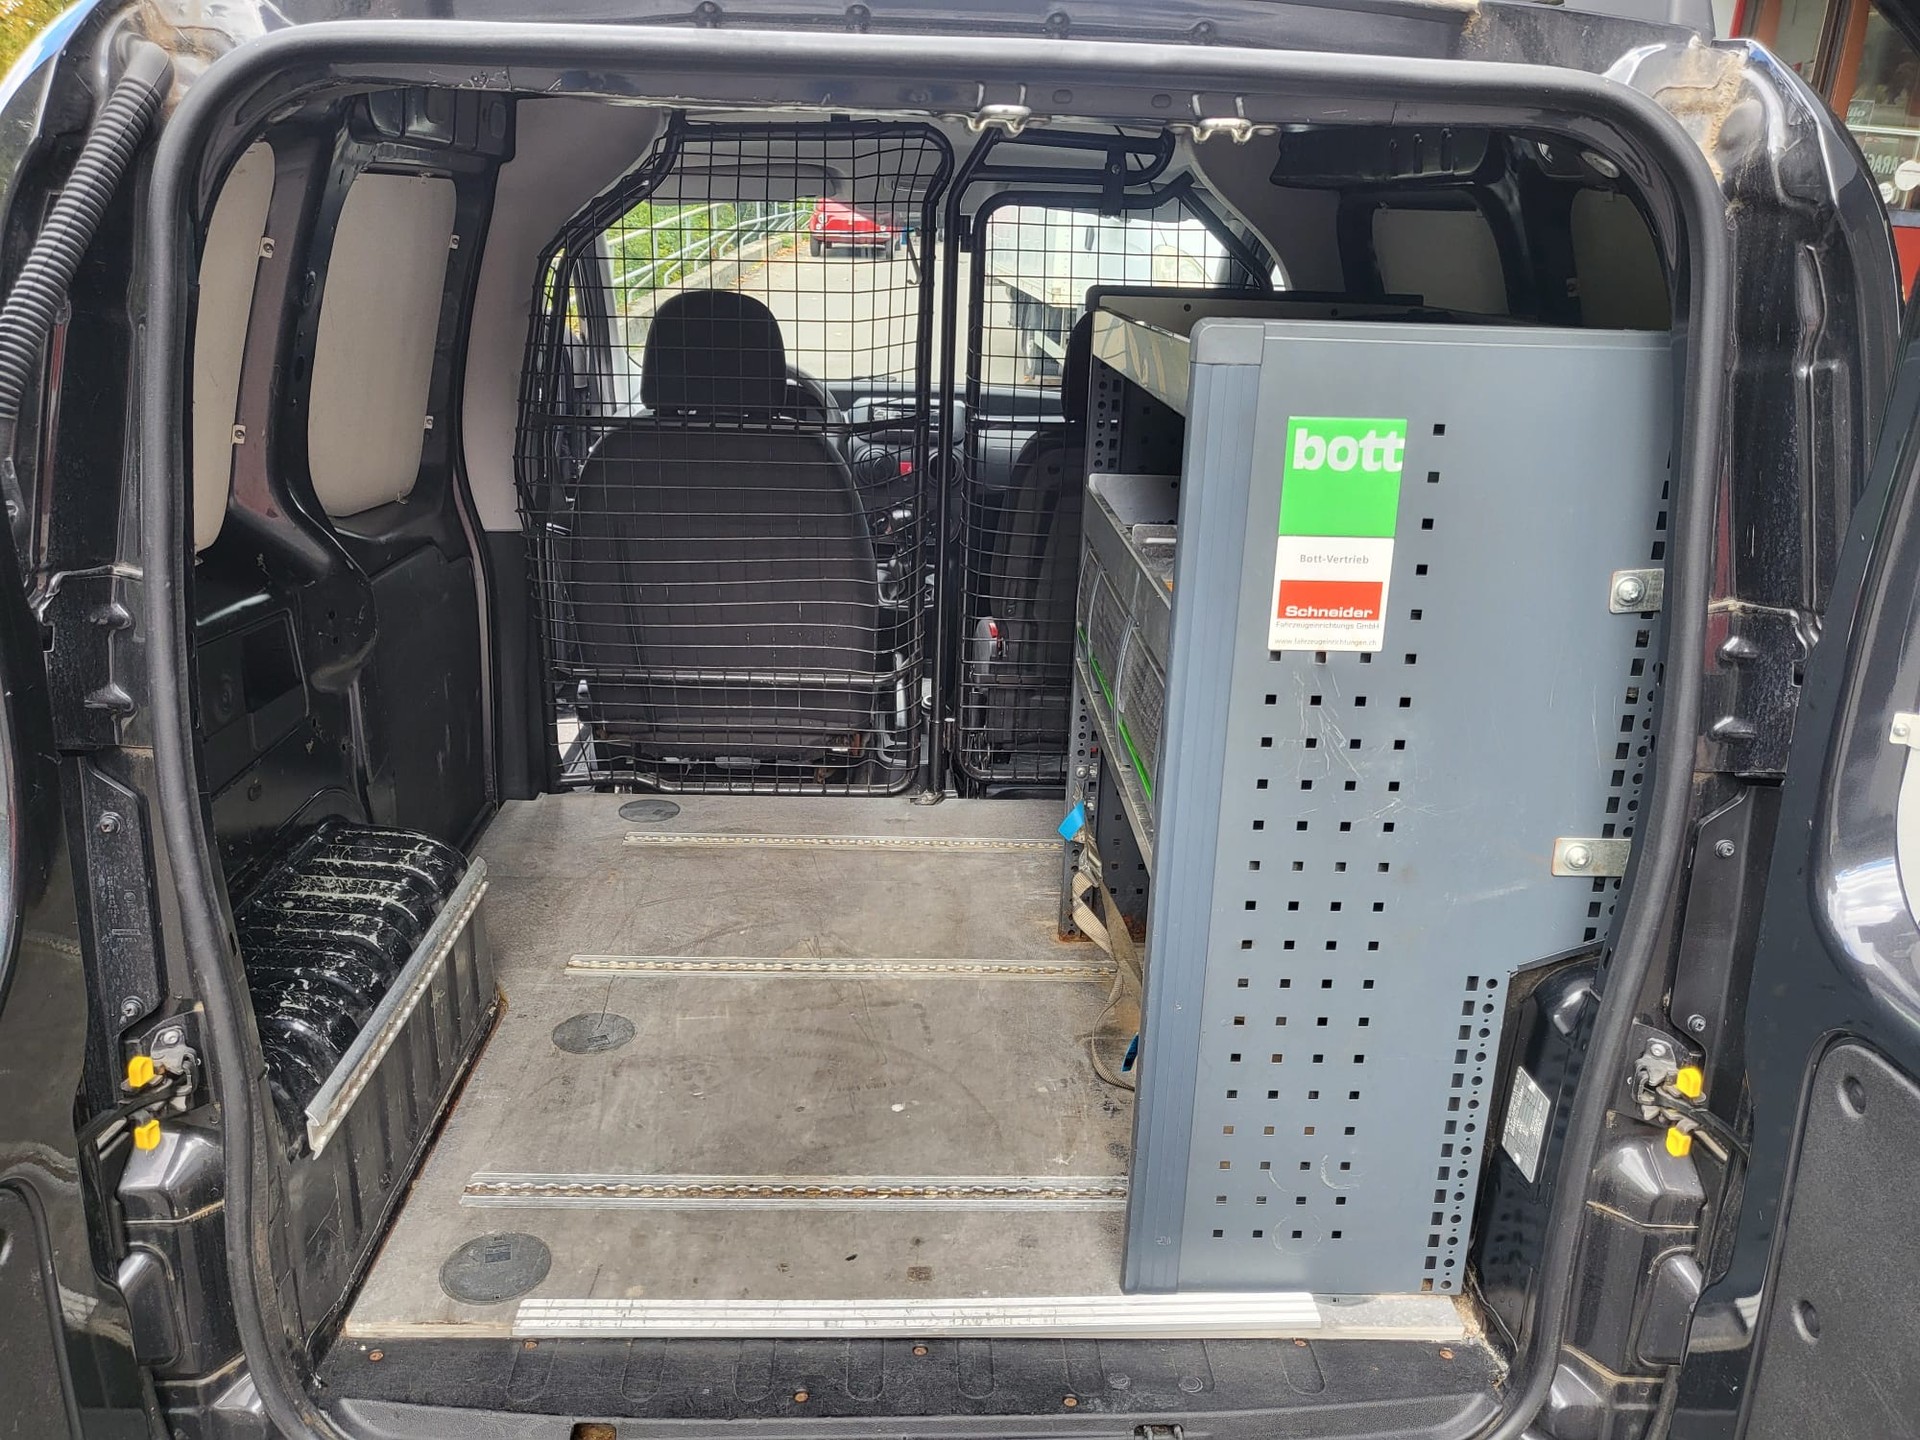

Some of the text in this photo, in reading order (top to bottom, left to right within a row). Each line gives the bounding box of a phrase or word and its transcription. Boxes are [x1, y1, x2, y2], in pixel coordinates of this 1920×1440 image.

[1293, 428, 1405, 472] bott
[1299, 554, 1369, 564] Bott-Vertrieb
[1285, 605, 1373, 618] Schneider
[1275, 621, 1379, 630] Fahrzeugeinrichtungs GmbH
[1274, 638, 1377, 647] www.fahrzeugeinrichtungen.ch
